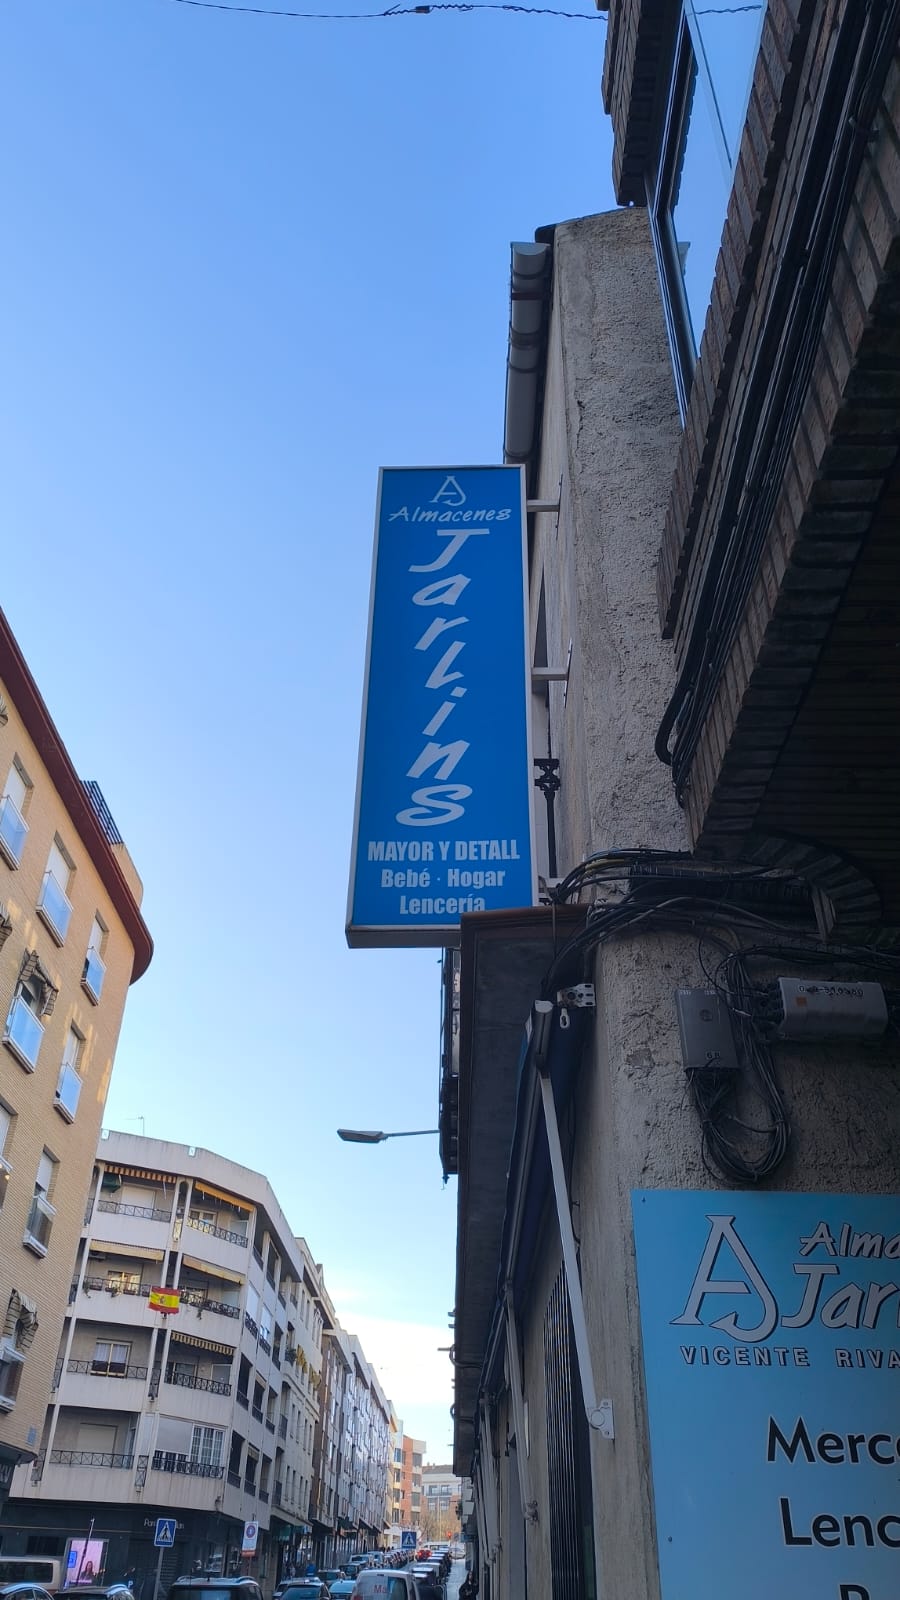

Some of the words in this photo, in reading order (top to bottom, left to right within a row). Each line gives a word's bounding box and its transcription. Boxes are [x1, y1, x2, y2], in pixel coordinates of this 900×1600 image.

[388, 505, 512, 522] Almacenes
[396, 527, 490, 827] Jarlins
[367, 840, 434, 862] MAYOR
[439, 840, 451, 861] Y
[455, 839, 521, 861] DETALL
[381, 867, 431, 888] Bebé
[447, 867, 506, 889] Hogar
[399, 893, 486, 915] Lencería
[781, 1263, 900, 1330] Jar
[679, 1345, 810, 1368] VICENTE
[766, 1415, 900, 1465] Merc
[779, 1496, 900, 1549] Lenc
